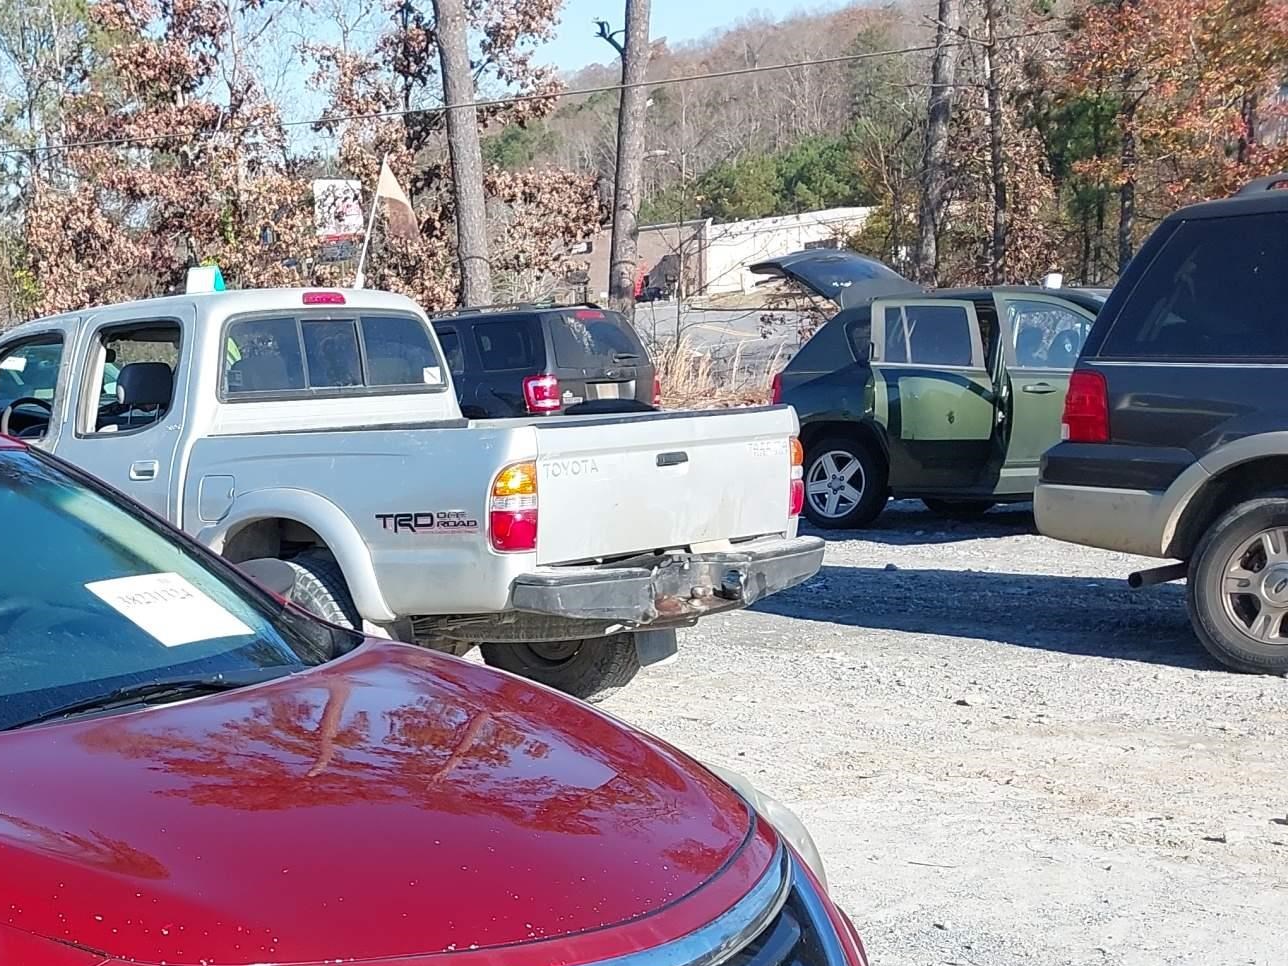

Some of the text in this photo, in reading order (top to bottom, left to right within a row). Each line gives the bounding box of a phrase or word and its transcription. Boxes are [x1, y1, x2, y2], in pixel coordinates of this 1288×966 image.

[543, 459, 599, 479] TOYOTA
[375, 513, 433, 533] TRD
[436, 520, 478, 528] ROAD
